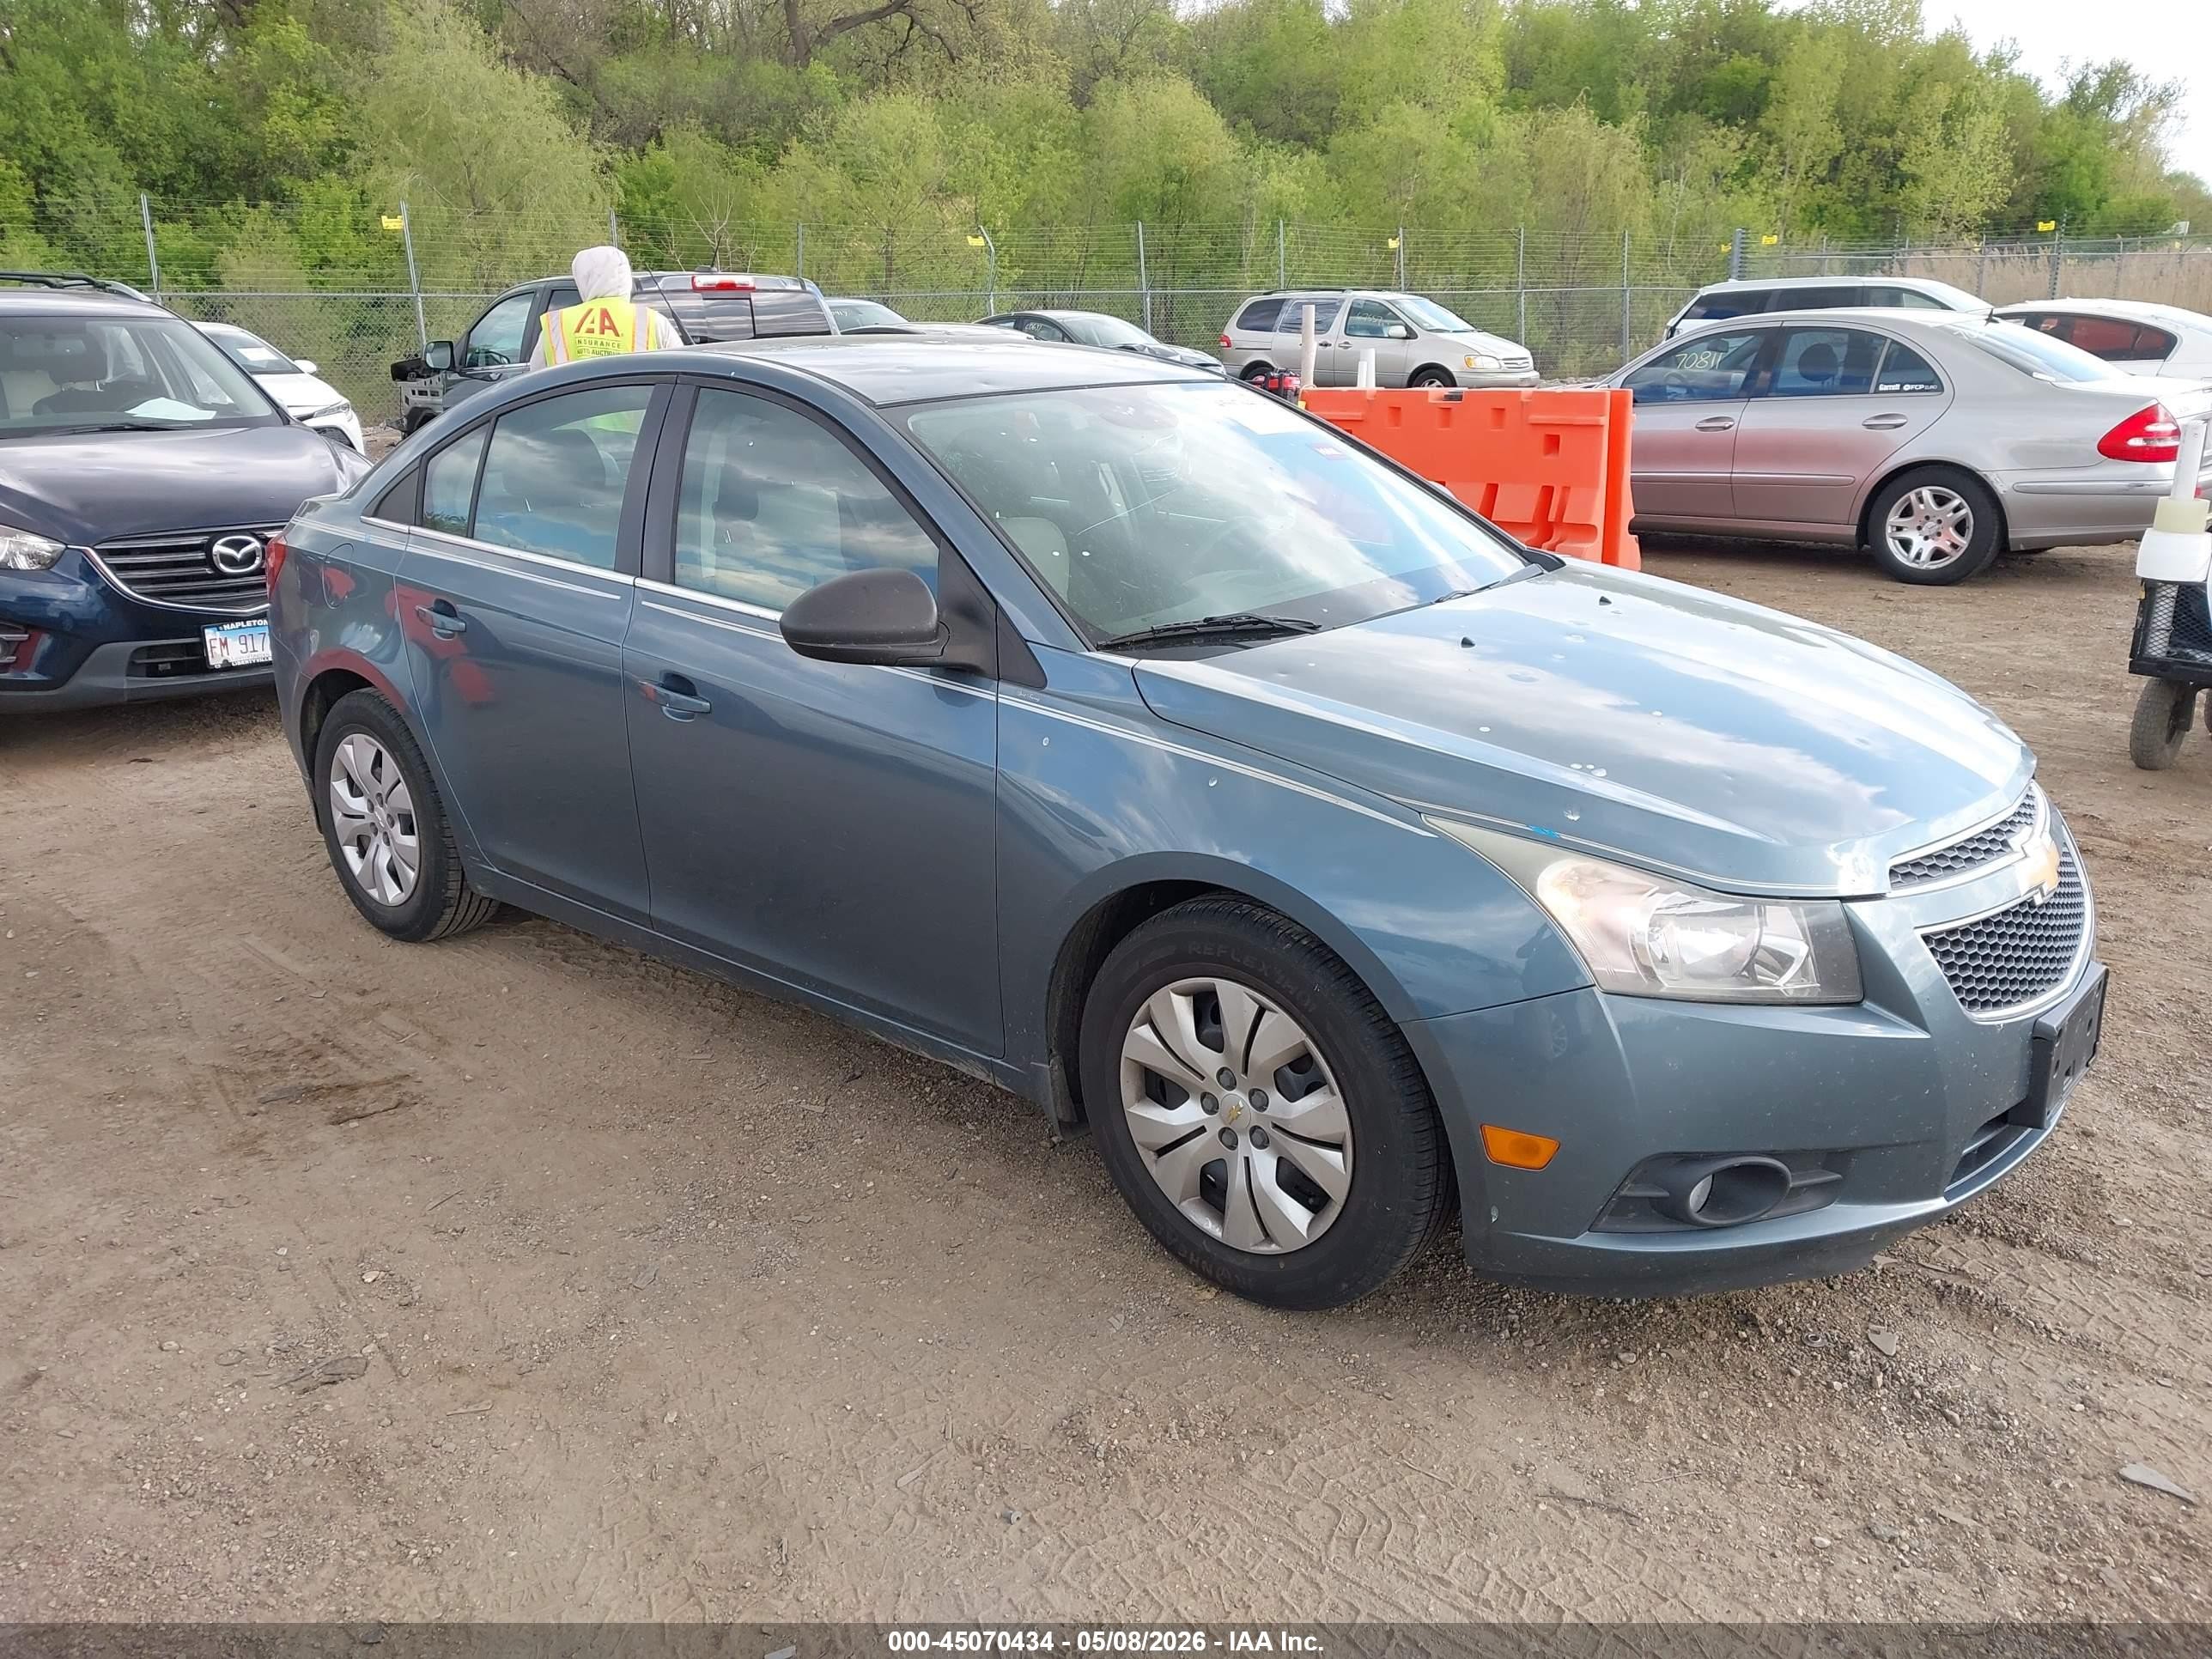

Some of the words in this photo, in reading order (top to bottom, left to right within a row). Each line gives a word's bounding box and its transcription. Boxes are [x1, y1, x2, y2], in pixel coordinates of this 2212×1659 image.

[1675, 351, 1724, 369] 70811
[210, 636, 230, 659] FM
[239, 632, 267, 654] 917
